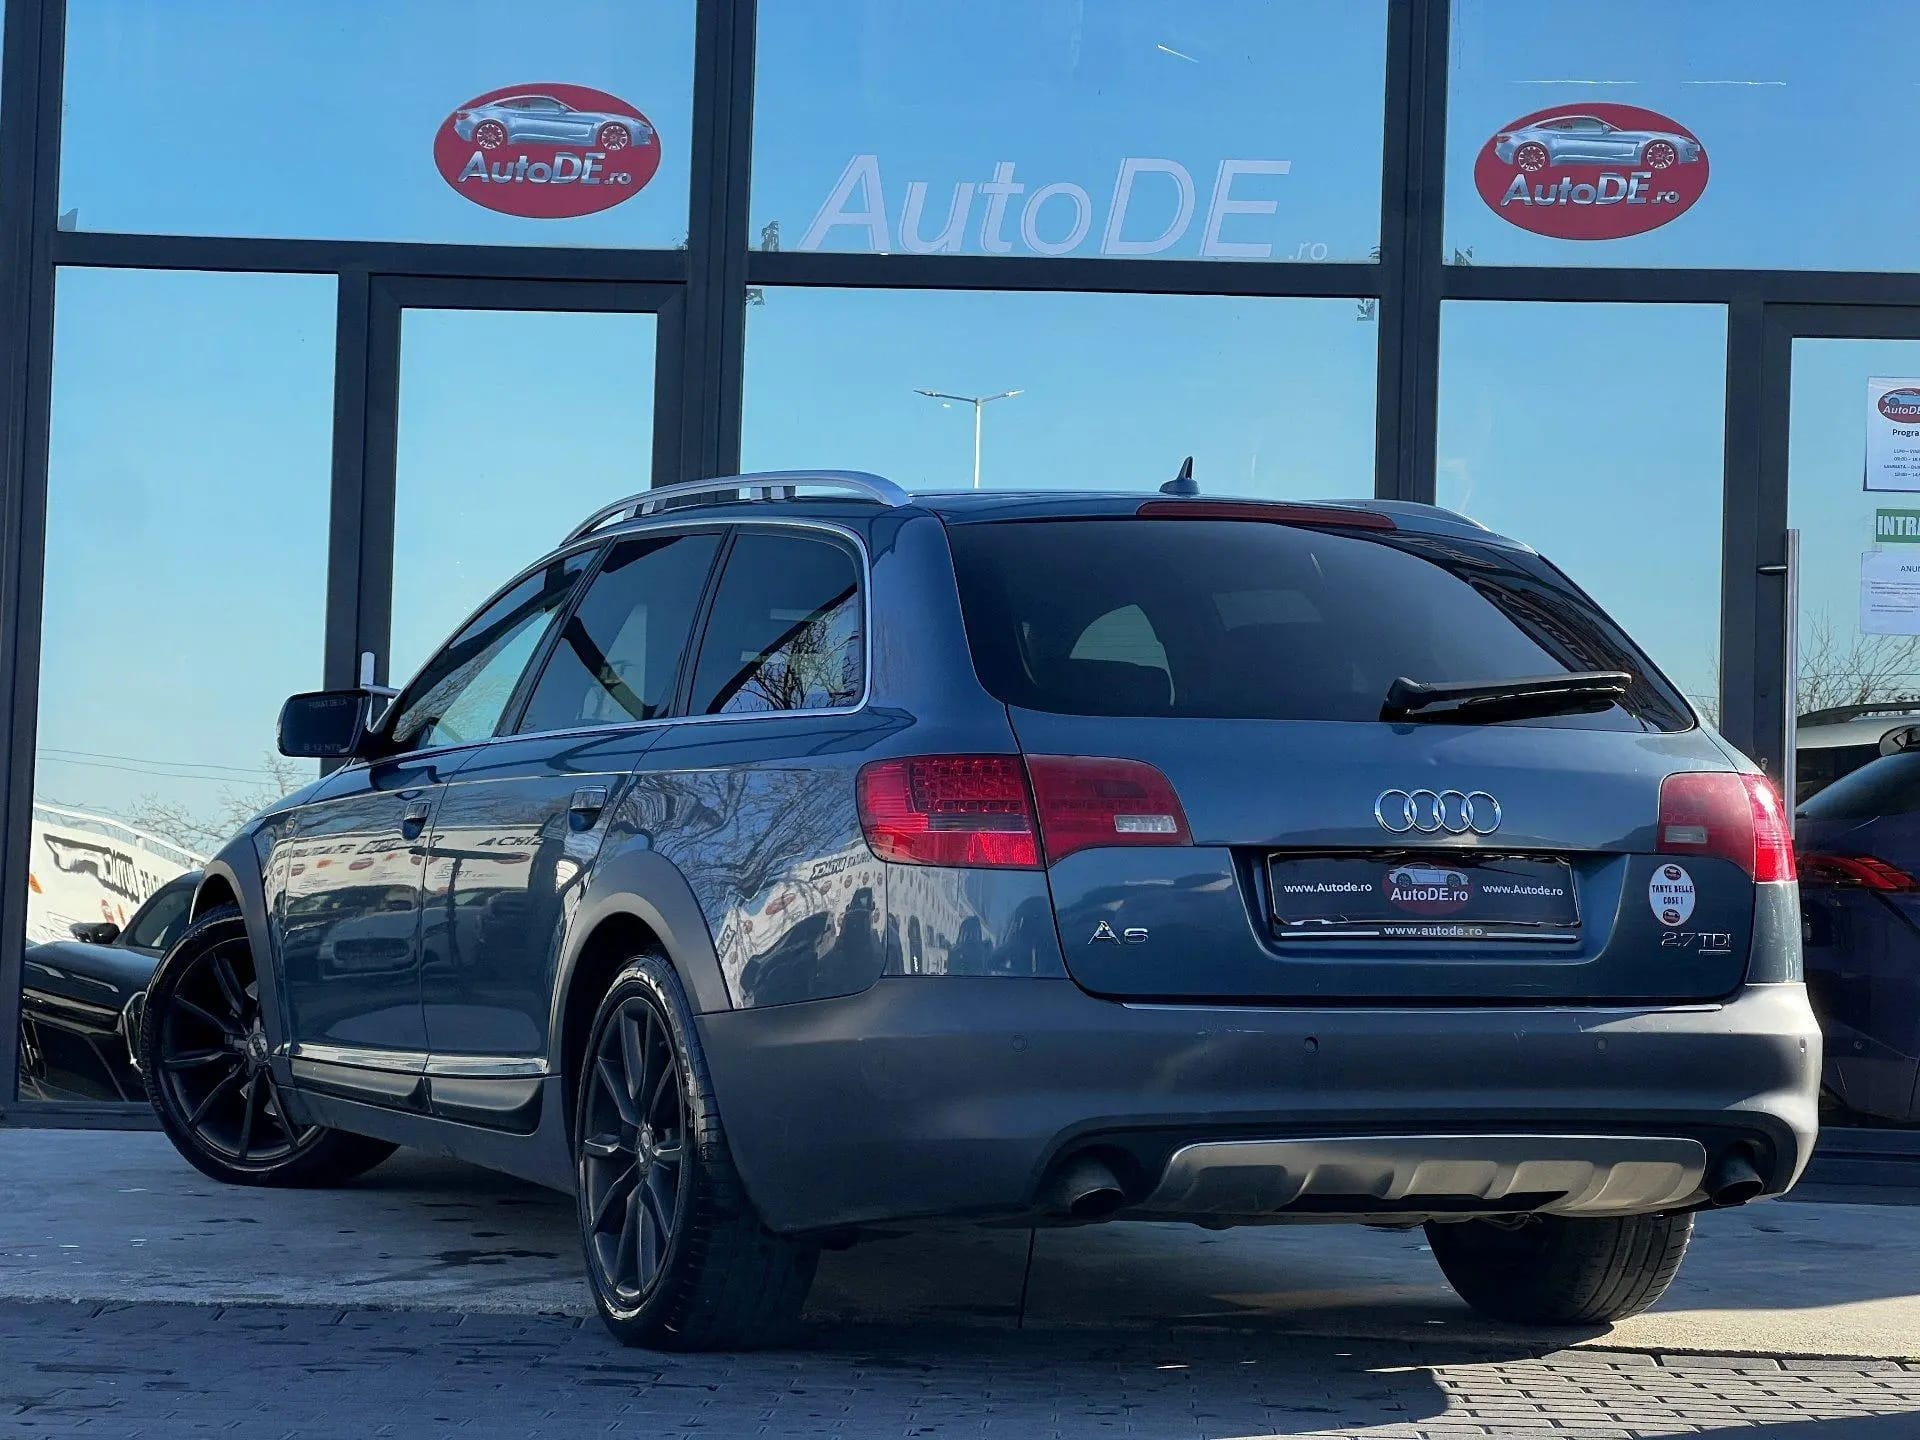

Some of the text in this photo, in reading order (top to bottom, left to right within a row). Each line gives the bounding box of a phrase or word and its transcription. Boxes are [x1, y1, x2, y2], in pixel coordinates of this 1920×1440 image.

[1284, 882, 1372, 893] www.Autode.ro
[1482, 884, 1564, 896] www.Autode.ro
[1390, 887, 1469, 901] AutoDE.ro
[1383, 925, 1483, 936] www.autode.ro
